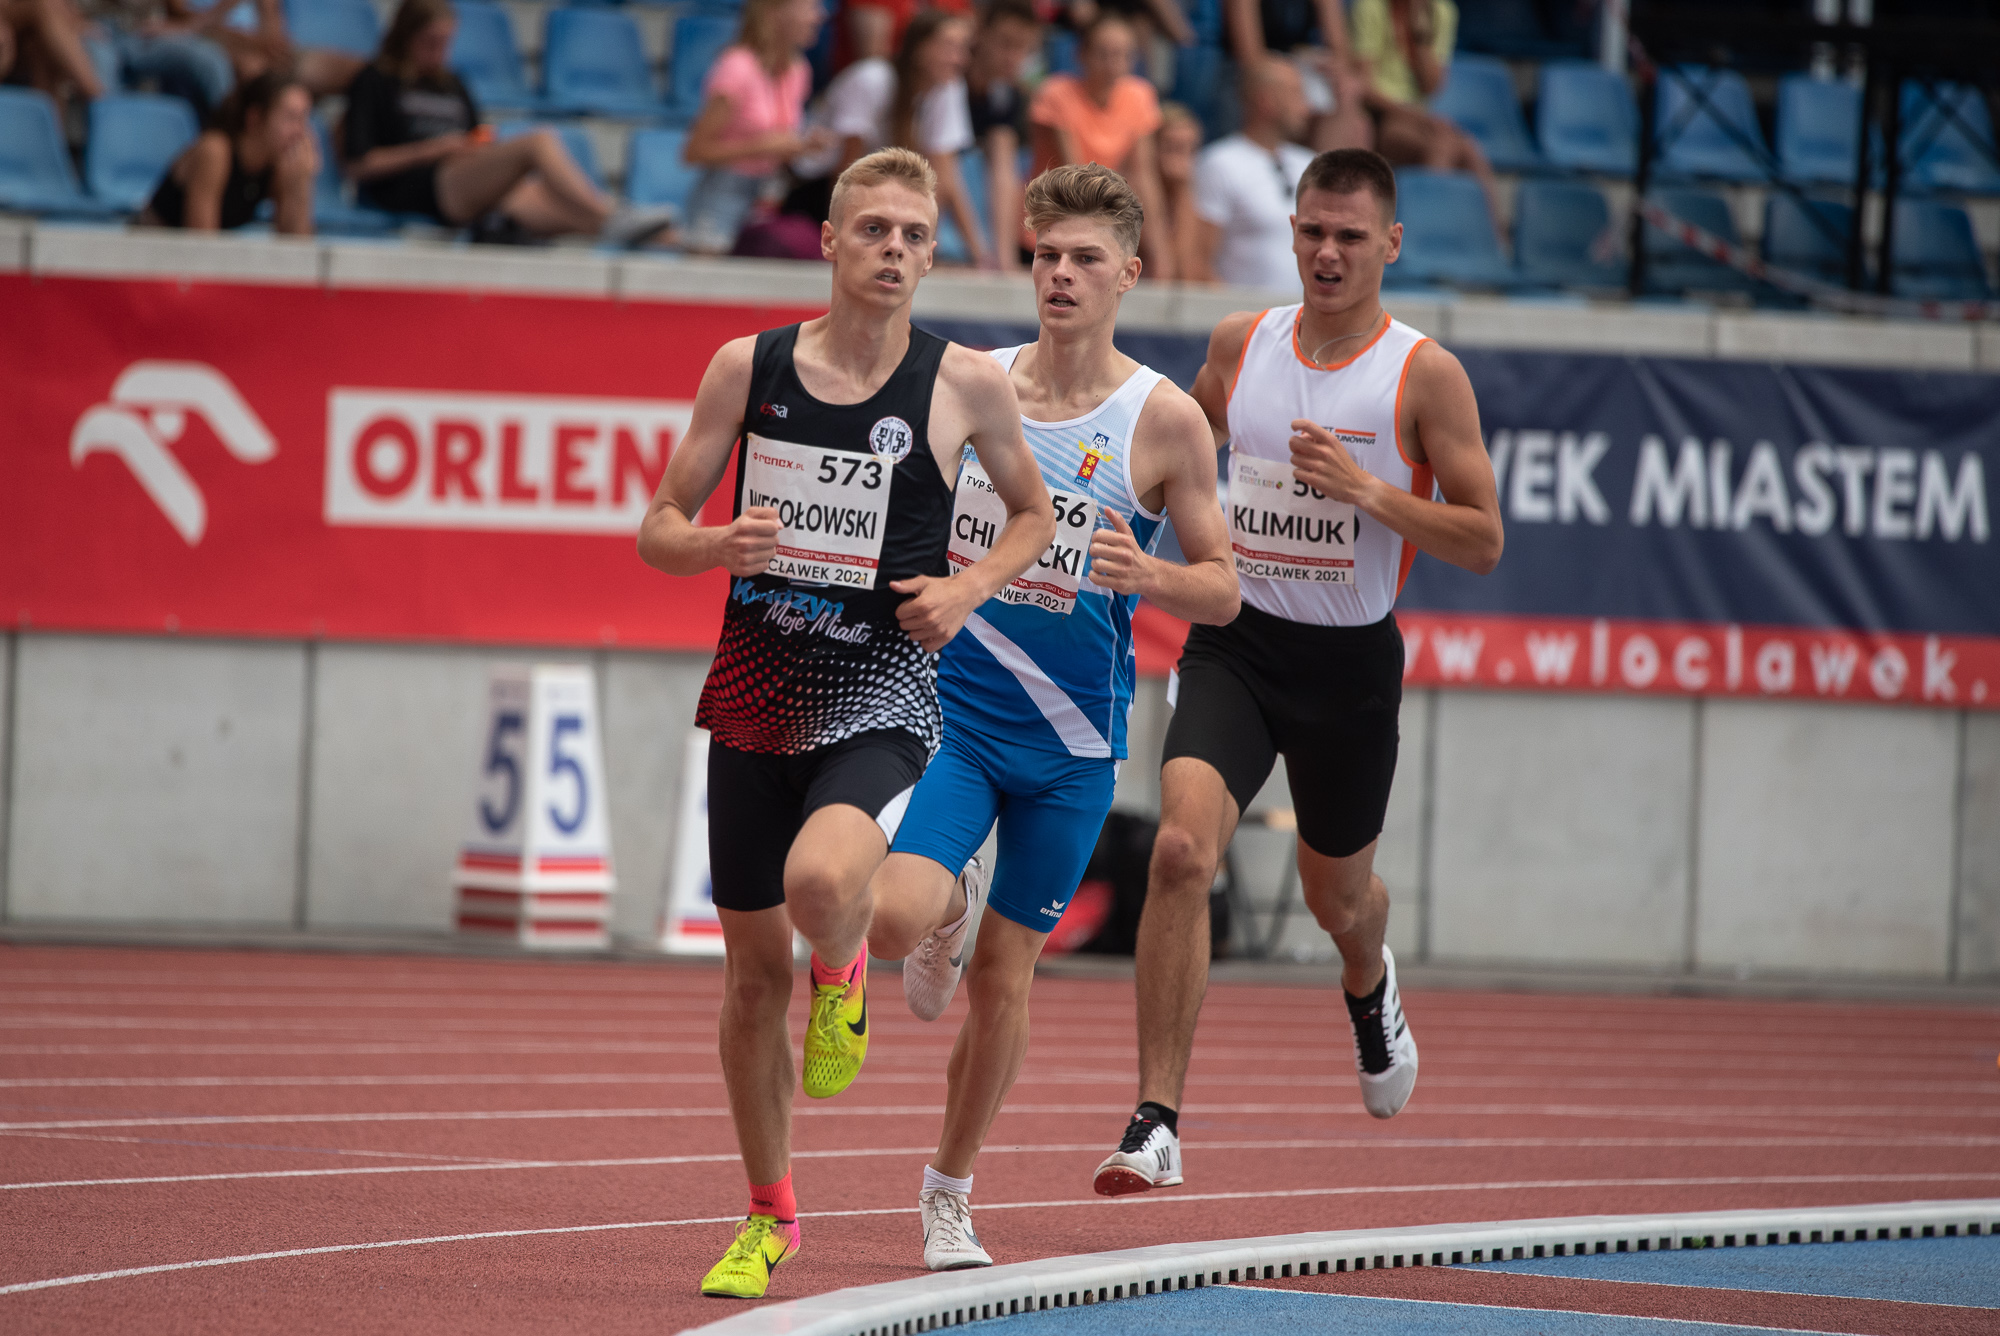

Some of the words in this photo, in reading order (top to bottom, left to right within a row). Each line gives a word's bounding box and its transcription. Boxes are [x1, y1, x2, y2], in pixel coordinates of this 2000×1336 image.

[352, 412, 674, 510] ORLEN
[817, 455, 882, 490] 573
[967, 475, 985, 489] TVP
[1628, 433, 1989, 544] MIASTEM
[1234, 505, 1346, 545] KLIMIUK
[828, 555, 858, 564] POLSKI
[1306, 558, 1334, 566] POLSKI
[834, 569, 868, 585] 2021
[1314, 570, 1346, 582] 2021
[1029, 582, 1056, 593] POLSKI
[1057, 588, 1071, 597] U18
[1034, 593, 1066, 610] 2021
[763, 600, 806, 635] Moje
[809, 612, 872, 643] Miasto
[480, 708, 524, 837] 5
[549, 714, 591, 834] 5
[1040, 907, 1062, 918] erima
